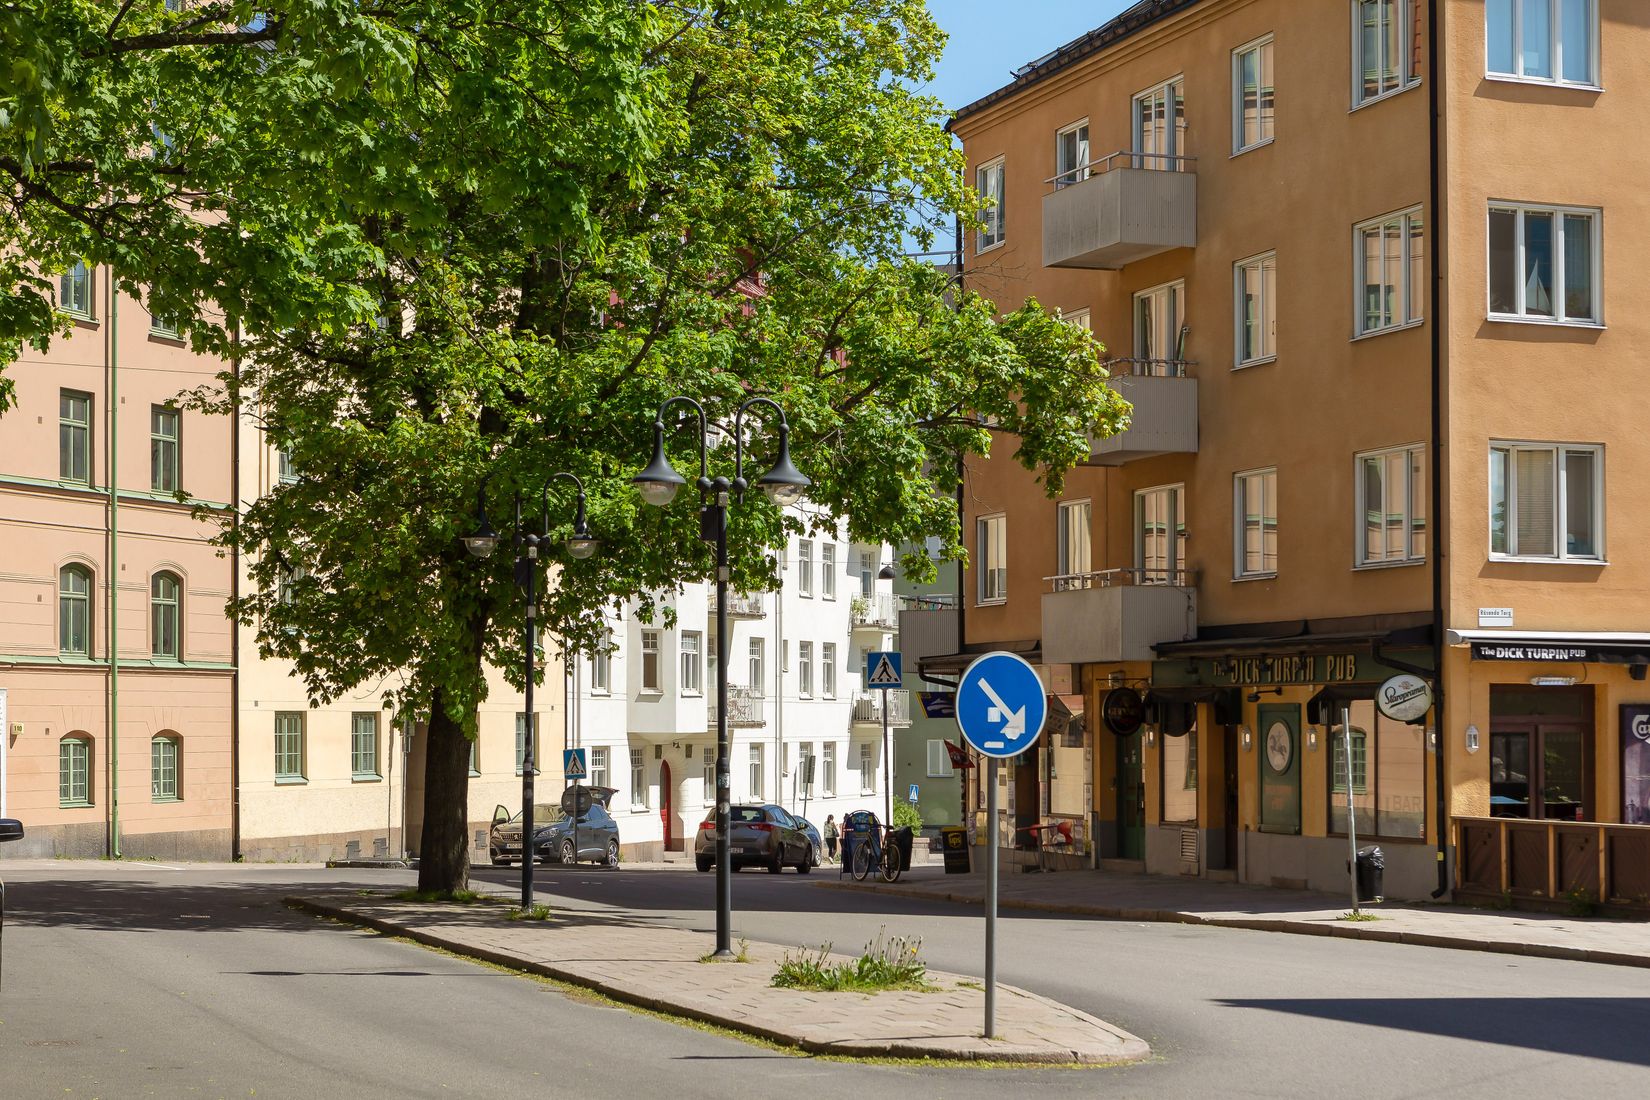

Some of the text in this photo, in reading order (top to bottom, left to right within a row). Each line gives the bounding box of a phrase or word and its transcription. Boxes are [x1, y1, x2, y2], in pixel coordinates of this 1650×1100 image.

[1480, 647, 1586, 660] The DICK TURPIN PUB
[1231, 658, 1260, 684] DICK
[1327, 654, 1355, 681] PUB
[1392, 795, 1423, 813] BAR
